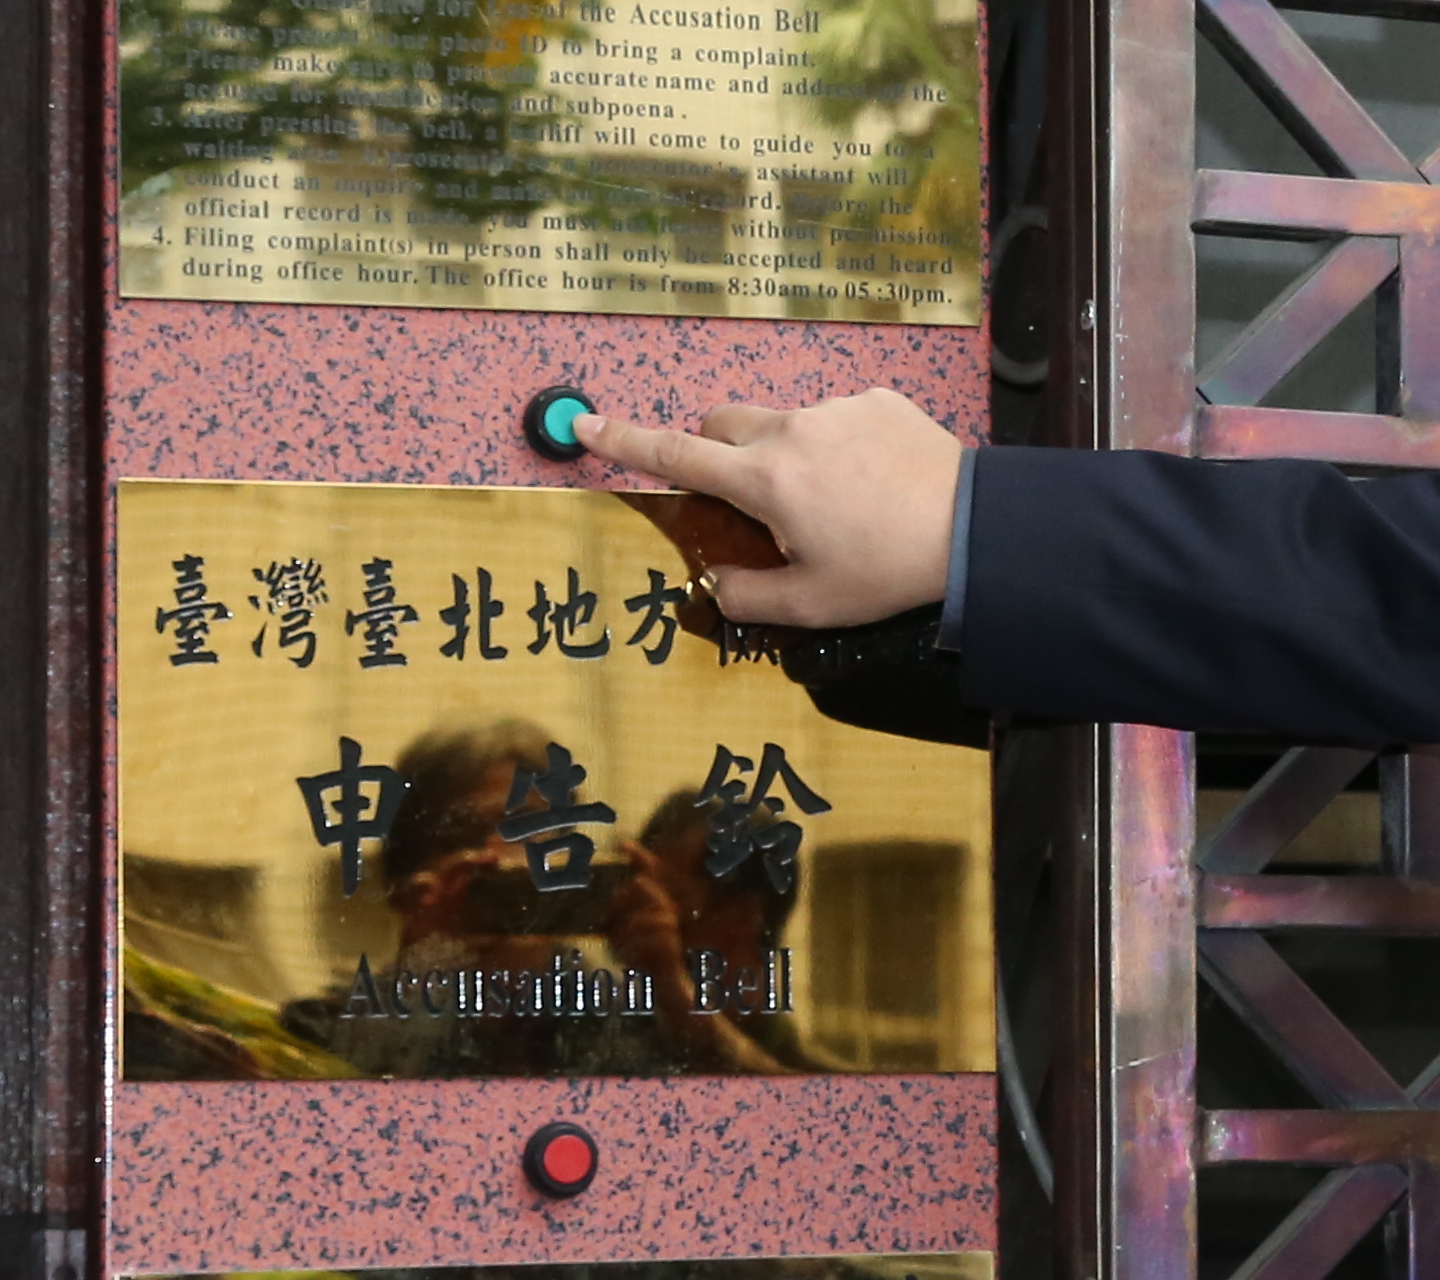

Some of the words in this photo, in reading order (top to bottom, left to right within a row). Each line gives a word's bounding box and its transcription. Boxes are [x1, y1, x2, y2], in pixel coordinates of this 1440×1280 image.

[579, 0, 616, 24] the
[630, 3, 760, 31] Accusation
[775, 9, 820, 34] Bell
[440, 32, 507, 56] photo
[520, 34, 548, 55] ID
[562, 40, 582, 56] to
[595, 39, 659, 64] bring
[670, 47, 682, 61] a
[695, 46, 817, 70] complaint.
[273, 52, 337, 74] make
[549, 67, 648, 89] accurate
[655, 74, 716, 92] name
[728, 77, 769, 95] and
[912, 84, 947, 104] the
[512, 94, 556, 115] and
[566, 97, 688, 120] subpoena.
[484, 127, 498, 141] a
[595, 127, 636, 147] will
[649, 131, 707, 149] come
[720, 134, 740, 150] to
[753, 134, 815, 157] guide
[832, 141, 872, 160] you
[884, 141, 905, 157] to
[184, 169, 280, 190] conduct
[293, 176, 320, 191] an
[879, 198, 914, 216] the
[756, 163, 855, 185] assistant
[867, 167, 909, 187] will
[185, 199, 270, 220] official
[283, 204, 360, 223] record
[374, 206, 392, 224] is
[543, 215, 599, 232] must
[730, 220, 819, 241] without
[151, 225, 173, 246] 4.
[184, 226, 255, 251] Filing
[267, 233, 414, 257] complaint(s)
[428, 237, 449, 256] in
[464, 243, 542, 262] person
[554, 243, 610, 263] shall
[622, 245, 673, 269] only
[722, 251, 823, 273] accepted
[835, 253, 876, 273] and
[889, 256, 954, 276] heard
[182, 258, 264, 283] during
[276, 262, 344, 282] office
[359, 265, 419, 285] hour.
[426, 265, 471, 287] The
[483, 269, 549, 289] office
[561, 271, 616, 291] hour
[629, 274, 647, 292] is
[660, 275, 716, 294] from
[727, 276, 810, 299] 8:30am
[817, 282, 838, 300] to
[156, 553, 782, 669] 臺灣臺北地方
[295, 735, 832, 897] 申告鈴
[338, 948, 656, 1019] Accusation
[687, 948, 795, 1015] Bell
